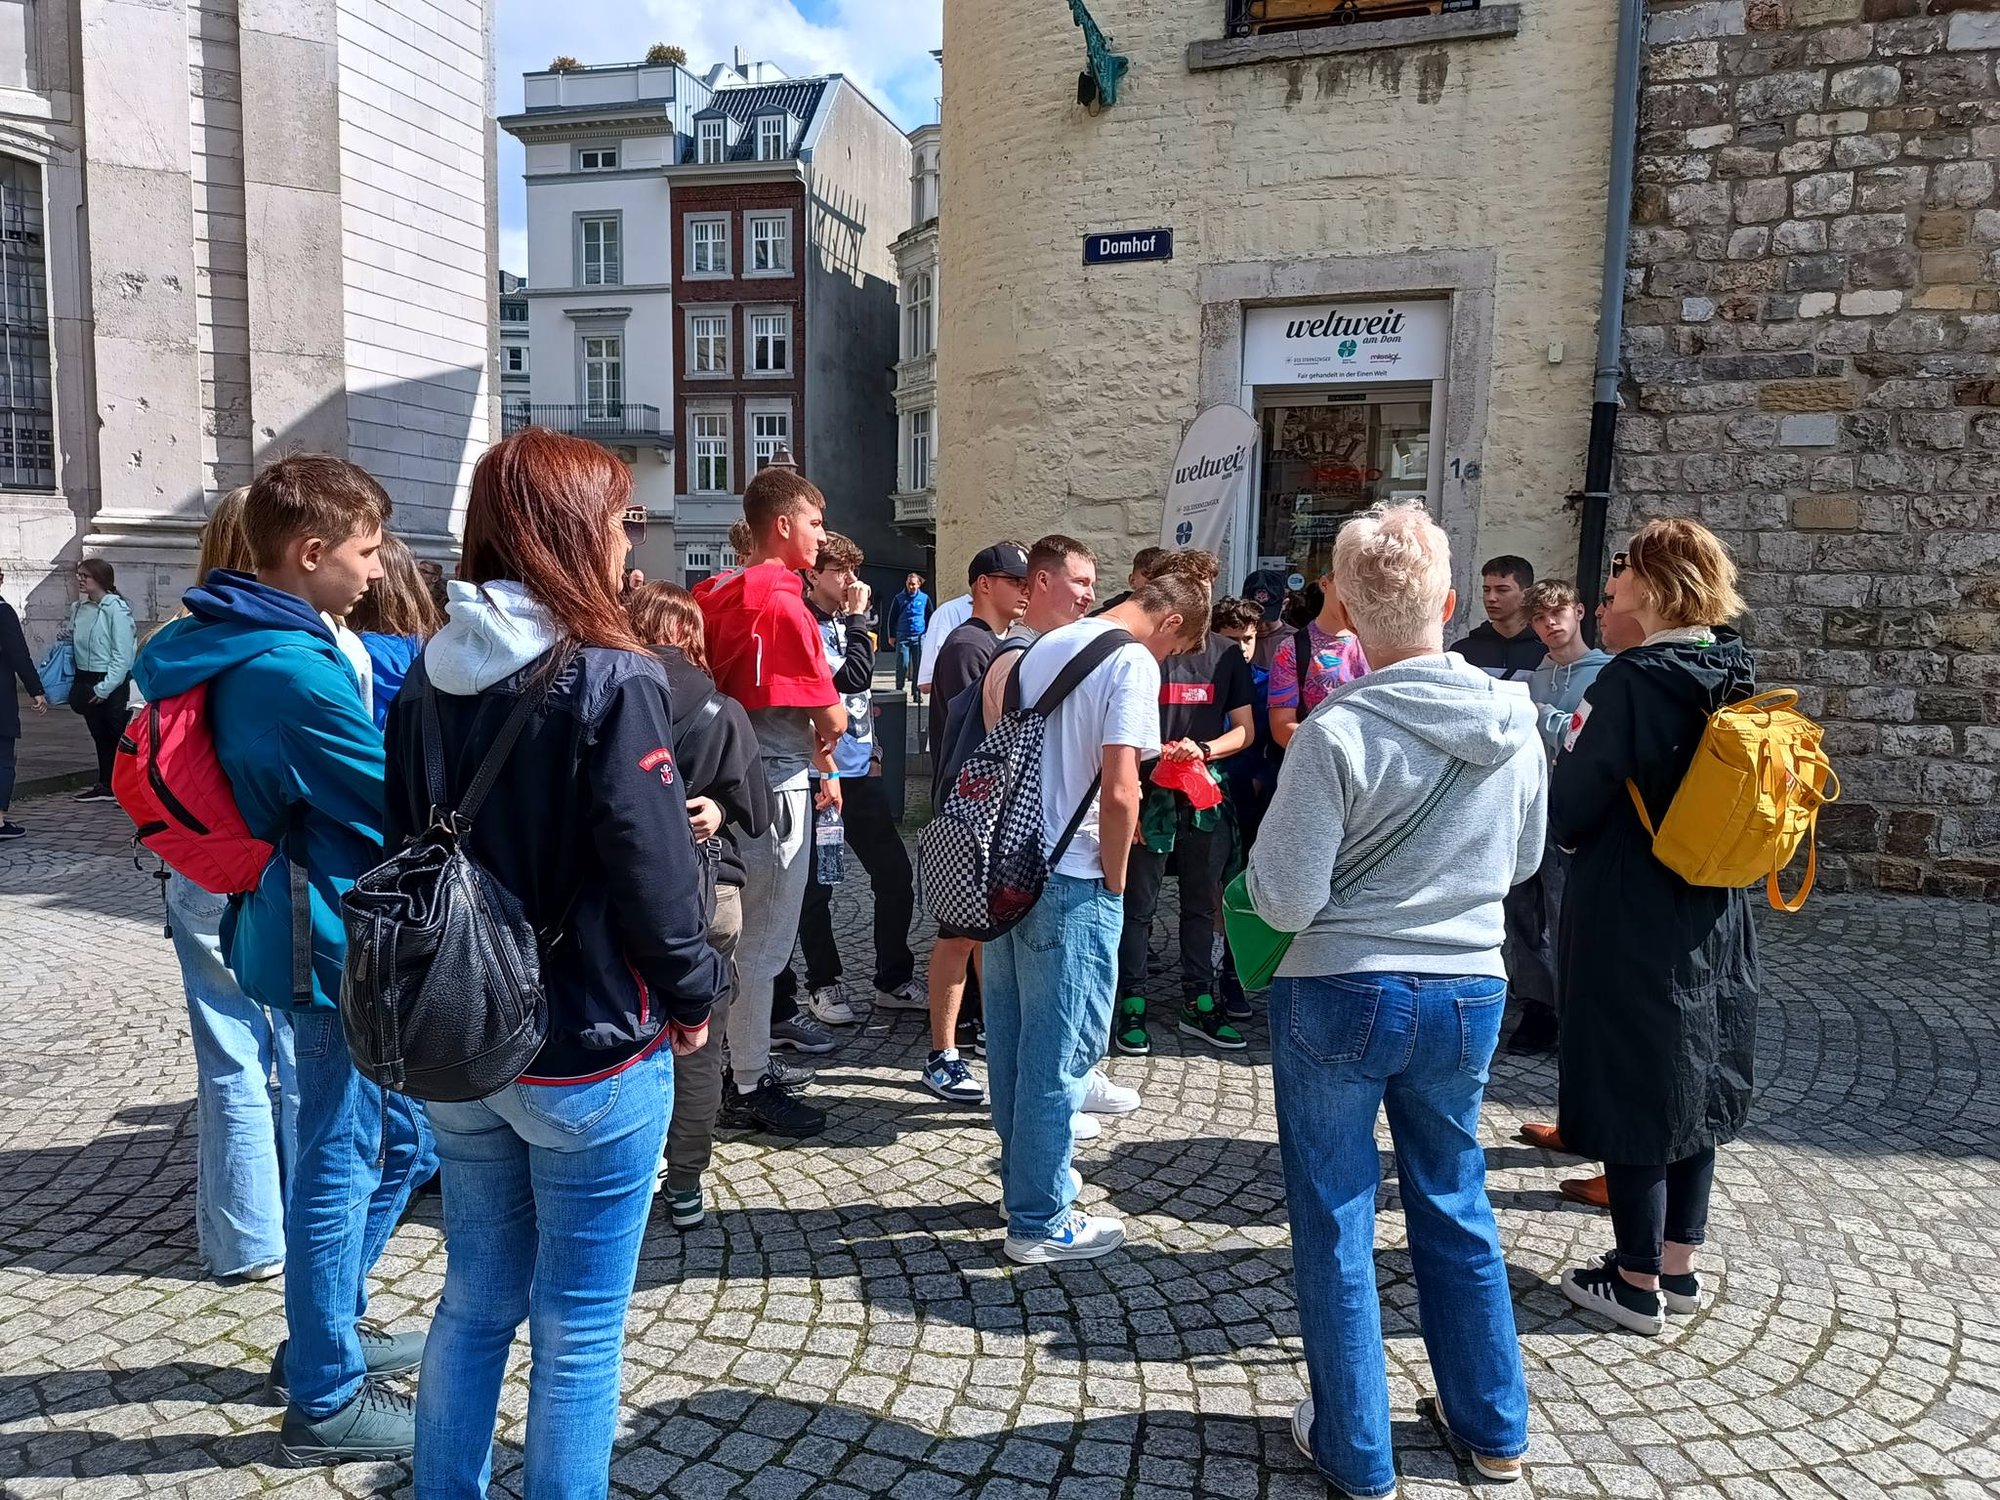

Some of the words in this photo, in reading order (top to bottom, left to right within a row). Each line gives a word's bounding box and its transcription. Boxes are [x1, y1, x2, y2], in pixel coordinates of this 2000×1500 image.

[1100, 235, 1156, 256] Domhof
[1285, 308, 1406, 339] weltweit
[1362, 336, 1378, 344] am
[1380, 335, 1402, 344] Dom
[1309, 371, 1338, 380] gehandelt
[1357, 370, 1374, 378] Einen
